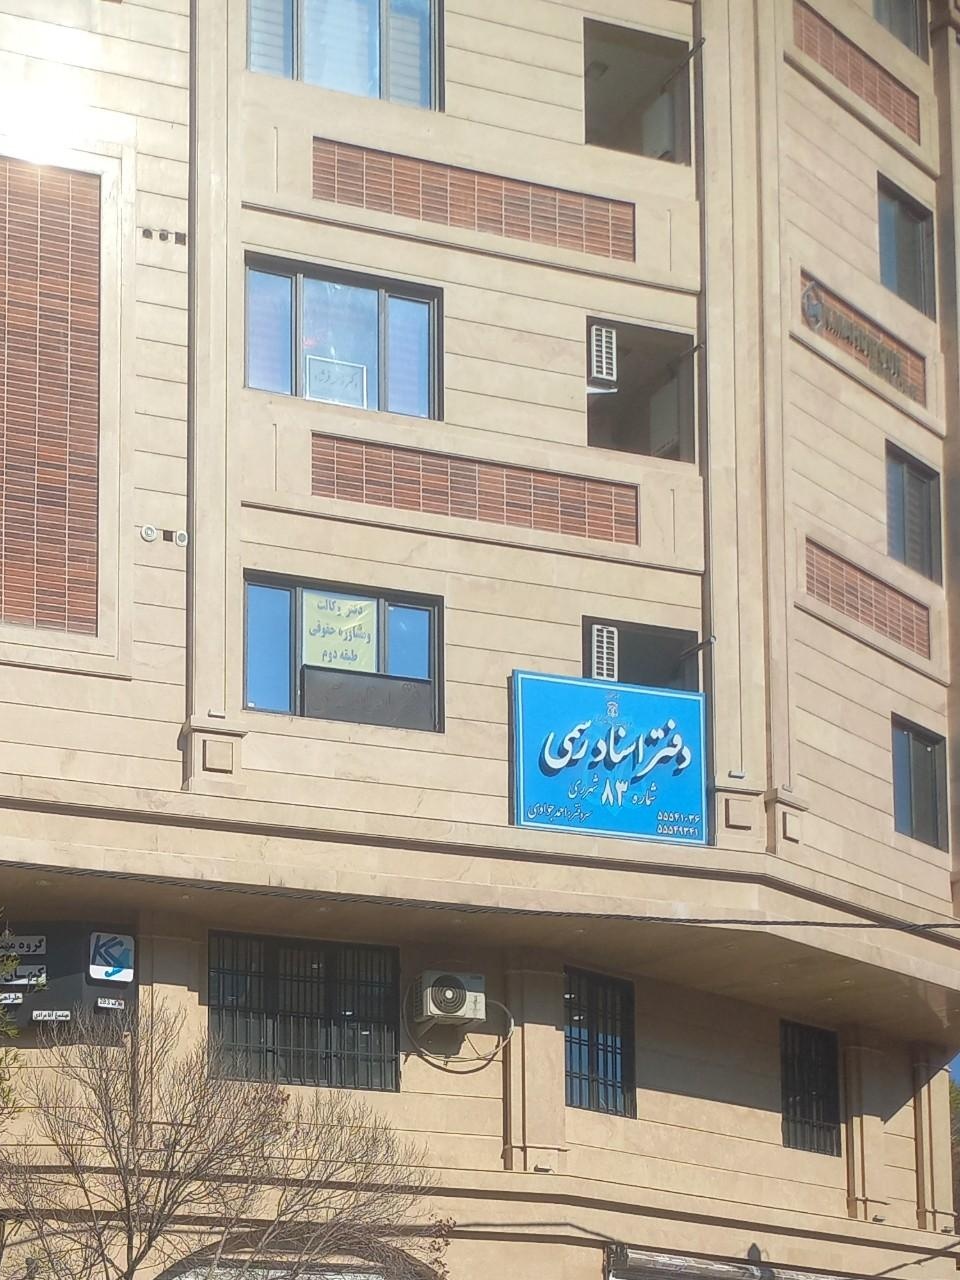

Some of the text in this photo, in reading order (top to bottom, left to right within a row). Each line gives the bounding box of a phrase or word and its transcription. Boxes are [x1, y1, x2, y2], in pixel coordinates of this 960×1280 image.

[317, 600, 341, 616] وکالت
[309, 620, 336, 637] حقوقی
[322, 649, 358, 664] طبقه دوم
[544, 719, 691, 777] دفتر اسناد رسمی
[601, 778, 628, 807] ۸۳
[632, 782, 656, 805] شماره
[18, 938, 44, 952] گروه
